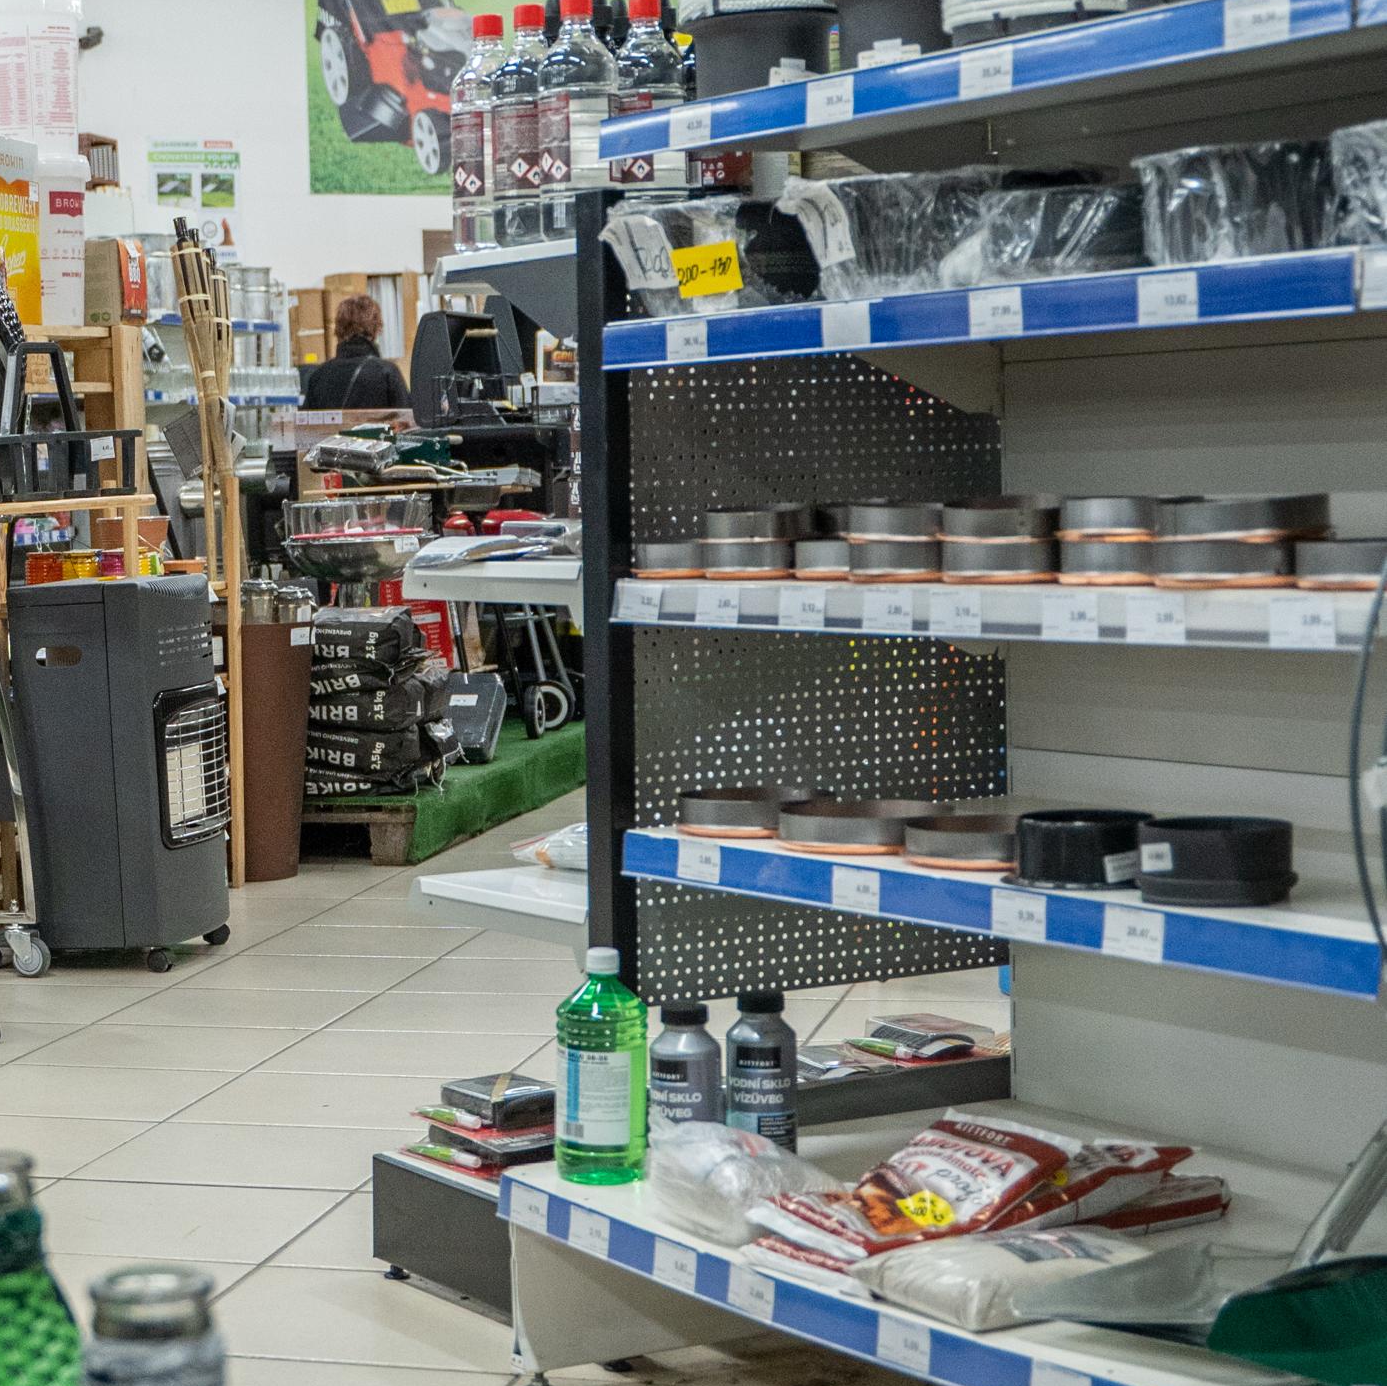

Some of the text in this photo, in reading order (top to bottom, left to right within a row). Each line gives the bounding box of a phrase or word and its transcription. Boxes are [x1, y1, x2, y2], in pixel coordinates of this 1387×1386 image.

[374, 690, 387, 704] kg
[372, 742, 386, 755] kg
[306, 746, 356, 767] BRIK
[762, 1077, 791, 1089] SKLO
[668, 1092, 703, 1103] SKLO
